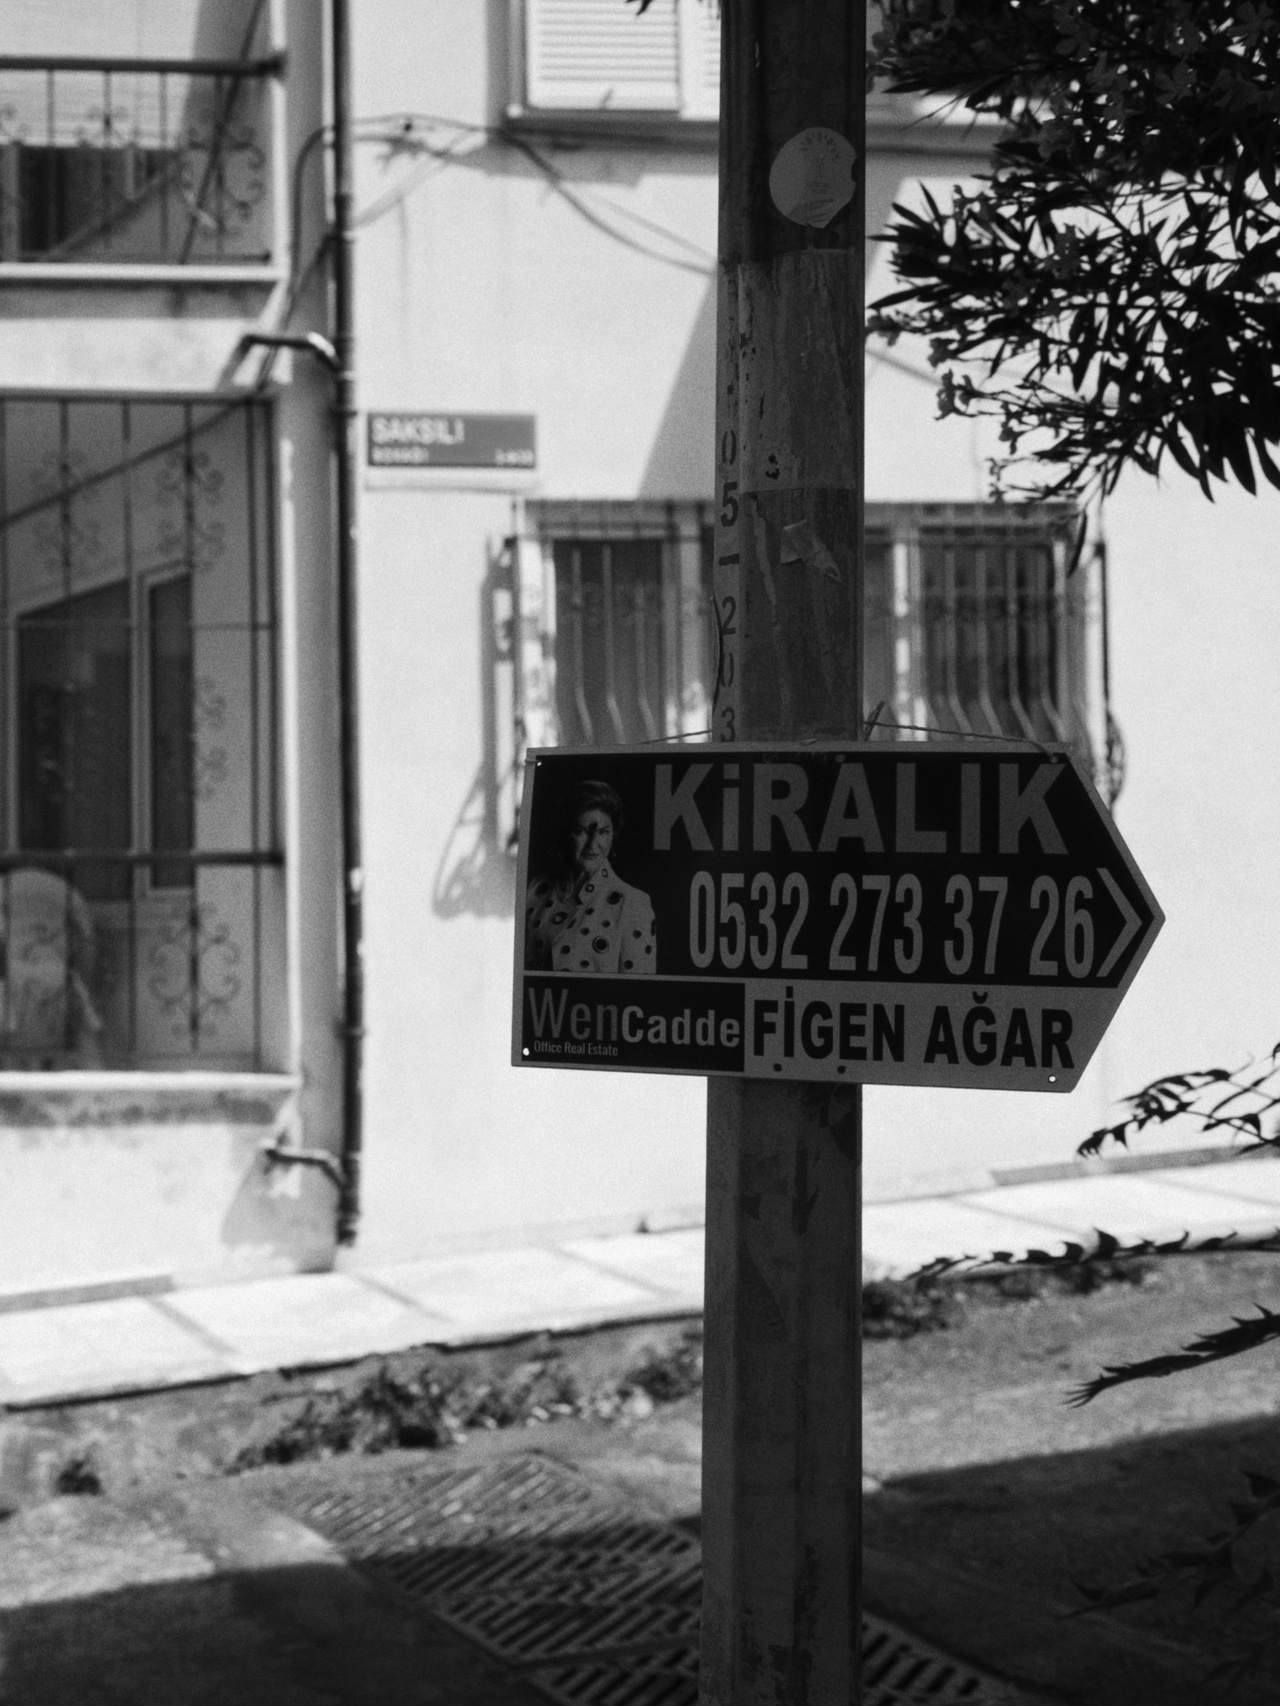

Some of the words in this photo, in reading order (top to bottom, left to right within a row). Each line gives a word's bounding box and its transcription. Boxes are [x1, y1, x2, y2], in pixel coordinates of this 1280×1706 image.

[689, 870, 809, 970] 0532
[828, 872, 924, 974] 273
[944, 874, 1009, 976] 37
[1029, 875, 1095, 979] 26
[534, 1040, 562, 1054] Office
[564, 1041, 586, 1055] Real
[587, 1042, 619, 1056] Estate
[753, 986, 906, 1062] FİGEN
[923, 991, 1075, 1070] AĞAR
